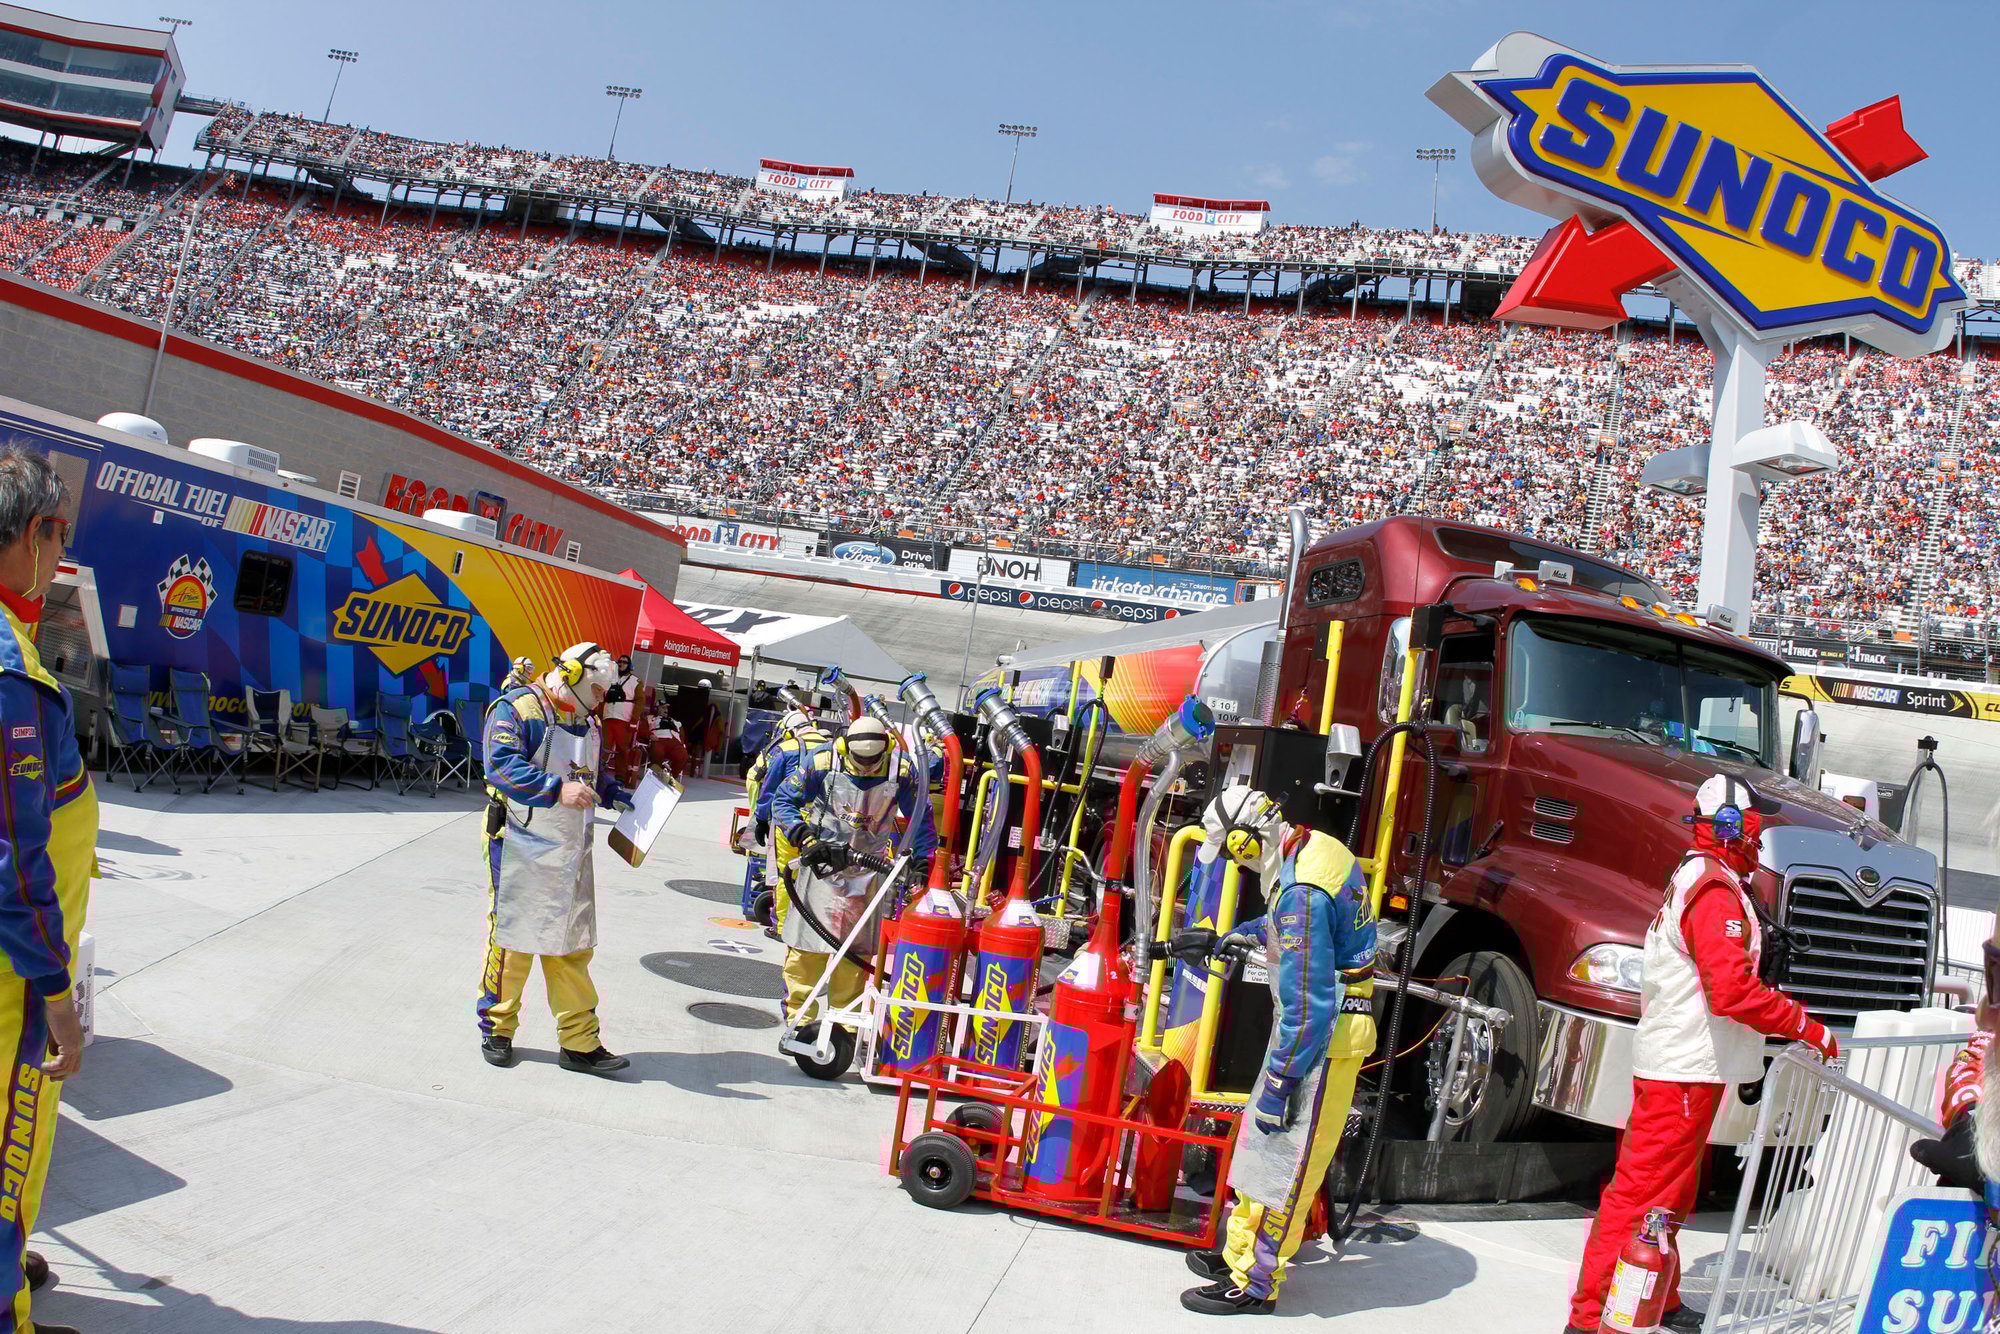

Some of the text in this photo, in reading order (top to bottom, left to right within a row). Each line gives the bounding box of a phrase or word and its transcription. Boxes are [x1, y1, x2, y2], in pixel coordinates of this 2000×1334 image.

[768, 173, 833, 189] FOOD CITY
[1539, 77, 1938, 309] SUNOCO
[1172, 210, 1243, 224] FOOD CITY
[96, 461, 229, 519] OFFICIAL FUEL
[201, 506, 331, 551] OF NASCAR
[739, 531, 783, 551] CITY
[901, 549, 933, 563] Drive
[977, 554, 1040, 582] UNOH
[1552, 570, 1568, 580] Mack
[967, 587, 1012, 603] pepsi
[173, 615, 203, 631] NASCAR
[338, 597, 467, 650] SUNOCO
[1718, 613, 1732, 624] Mack
[663, 639, 732, 661] Abingdon Fire Department
[1793, 647, 1819, 658] TRUCK
[1860, 653, 1887, 665] TRACK
[1852, 686, 1898, 704] NASCAR
[1906, 691, 1947, 709] Sprint
[1110, 971, 1118, 980] 2
[1, 1063, 42, 1222] SUNOCO
